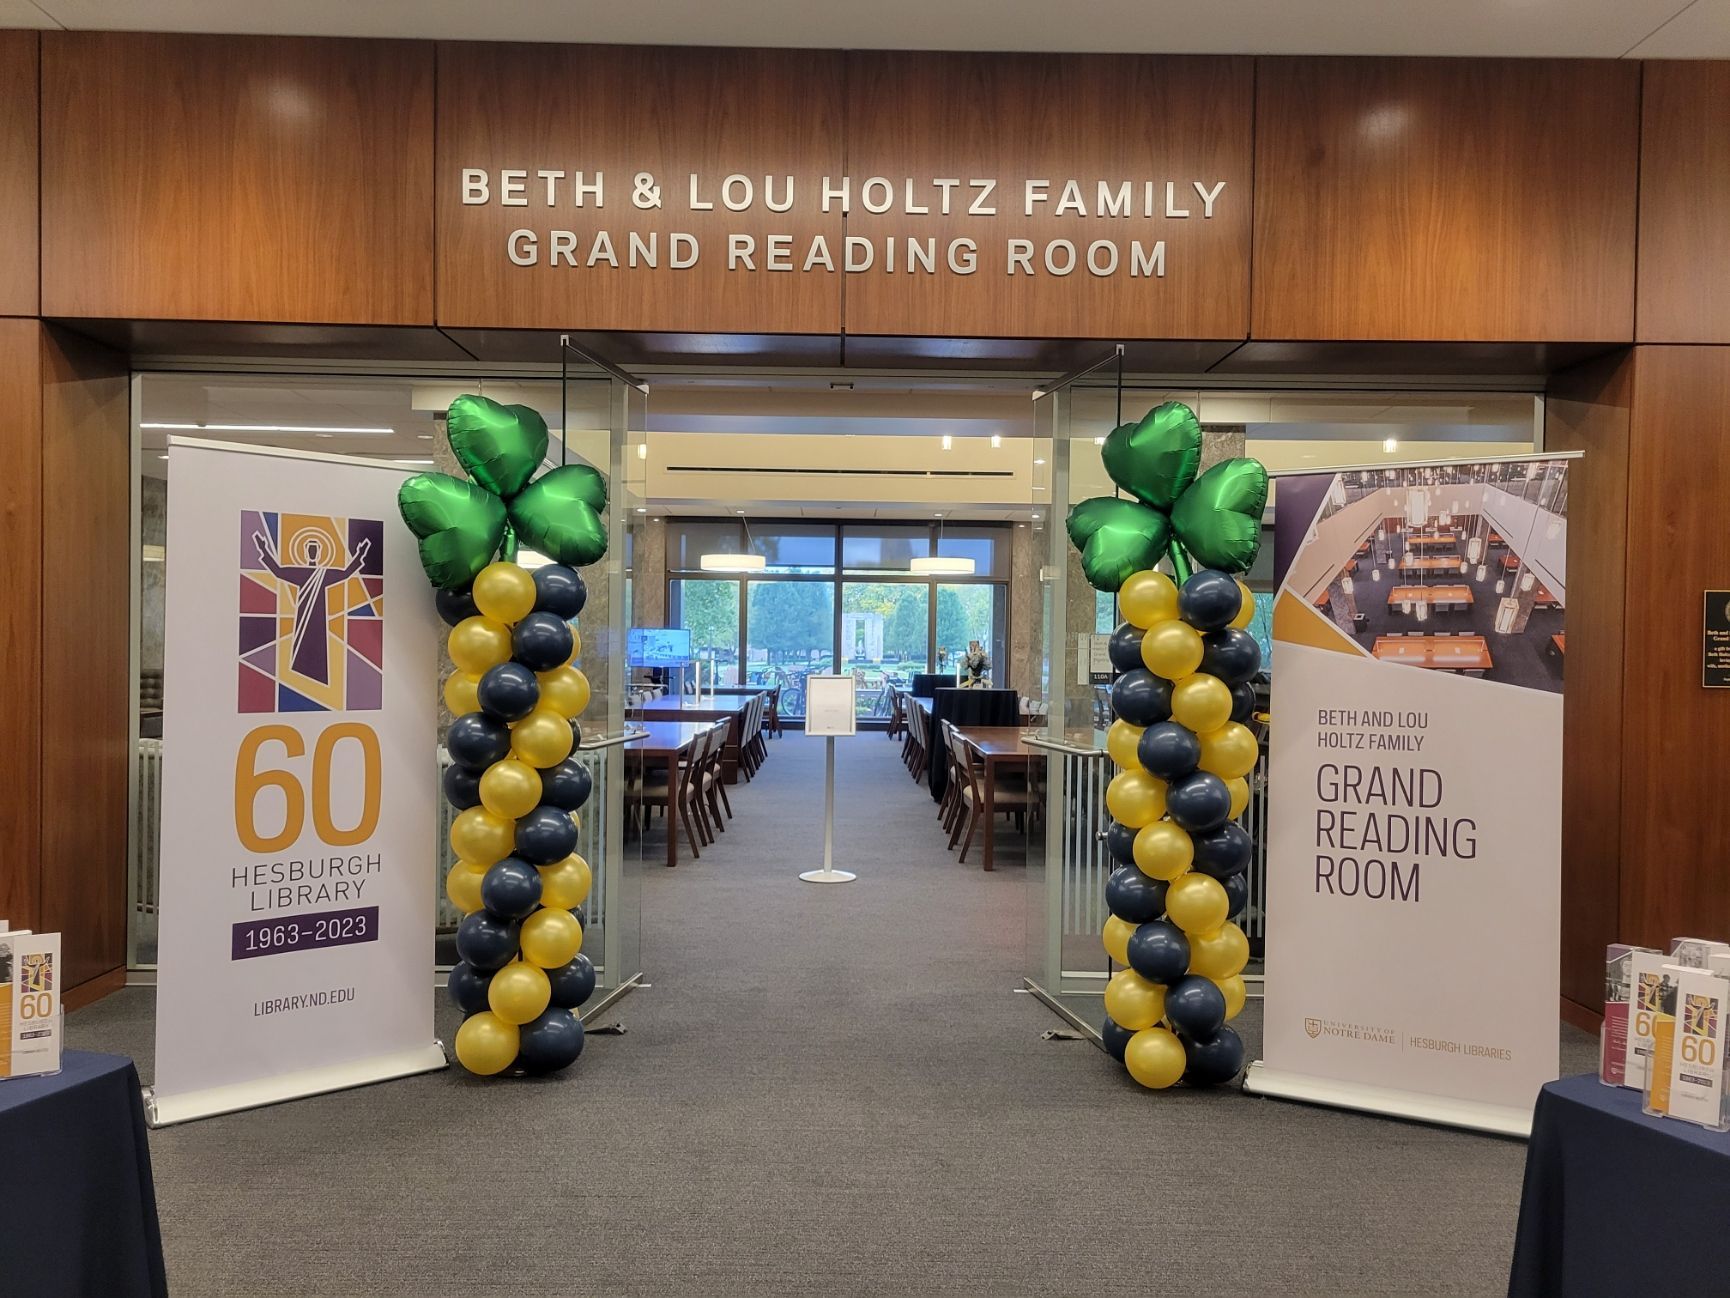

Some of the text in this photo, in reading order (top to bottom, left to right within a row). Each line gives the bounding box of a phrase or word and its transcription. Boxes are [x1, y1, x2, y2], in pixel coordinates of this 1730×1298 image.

[462, 168, 1226, 219] BETH & LOU HOLTZ FAMILY
[507, 229, 1166, 278] GRAND READING ROOM
[1318, 709, 1428, 729] BETH AND LOU
[1317, 731, 1425, 752] HOLTZ FAMILY
[234, 722, 382, 853] 60
[1316, 763, 1443, 809] GRAND
[1316, 809, 1477, 860] READING
[231, 853, 381, 888] HESBURGH
[1315, 854, 1420, 903] ROOM
[251, 879, 366, 911] LIBRARY
[245, 915, 367, 951] 1963-2023
[20, 992, 53, 1019] 60
[254, 987, 355, 1017] LIBRARY.ND.EDU
[1323, 1019, 1395, 1036] UNIVERSITY OF
[1323, 1026, 1396, 1044] NOTRE DAME
[1410, 1035, 1512, 1061] HESBURGH LIBRARIES
[1681, 1035, 1716, 1066] 60
